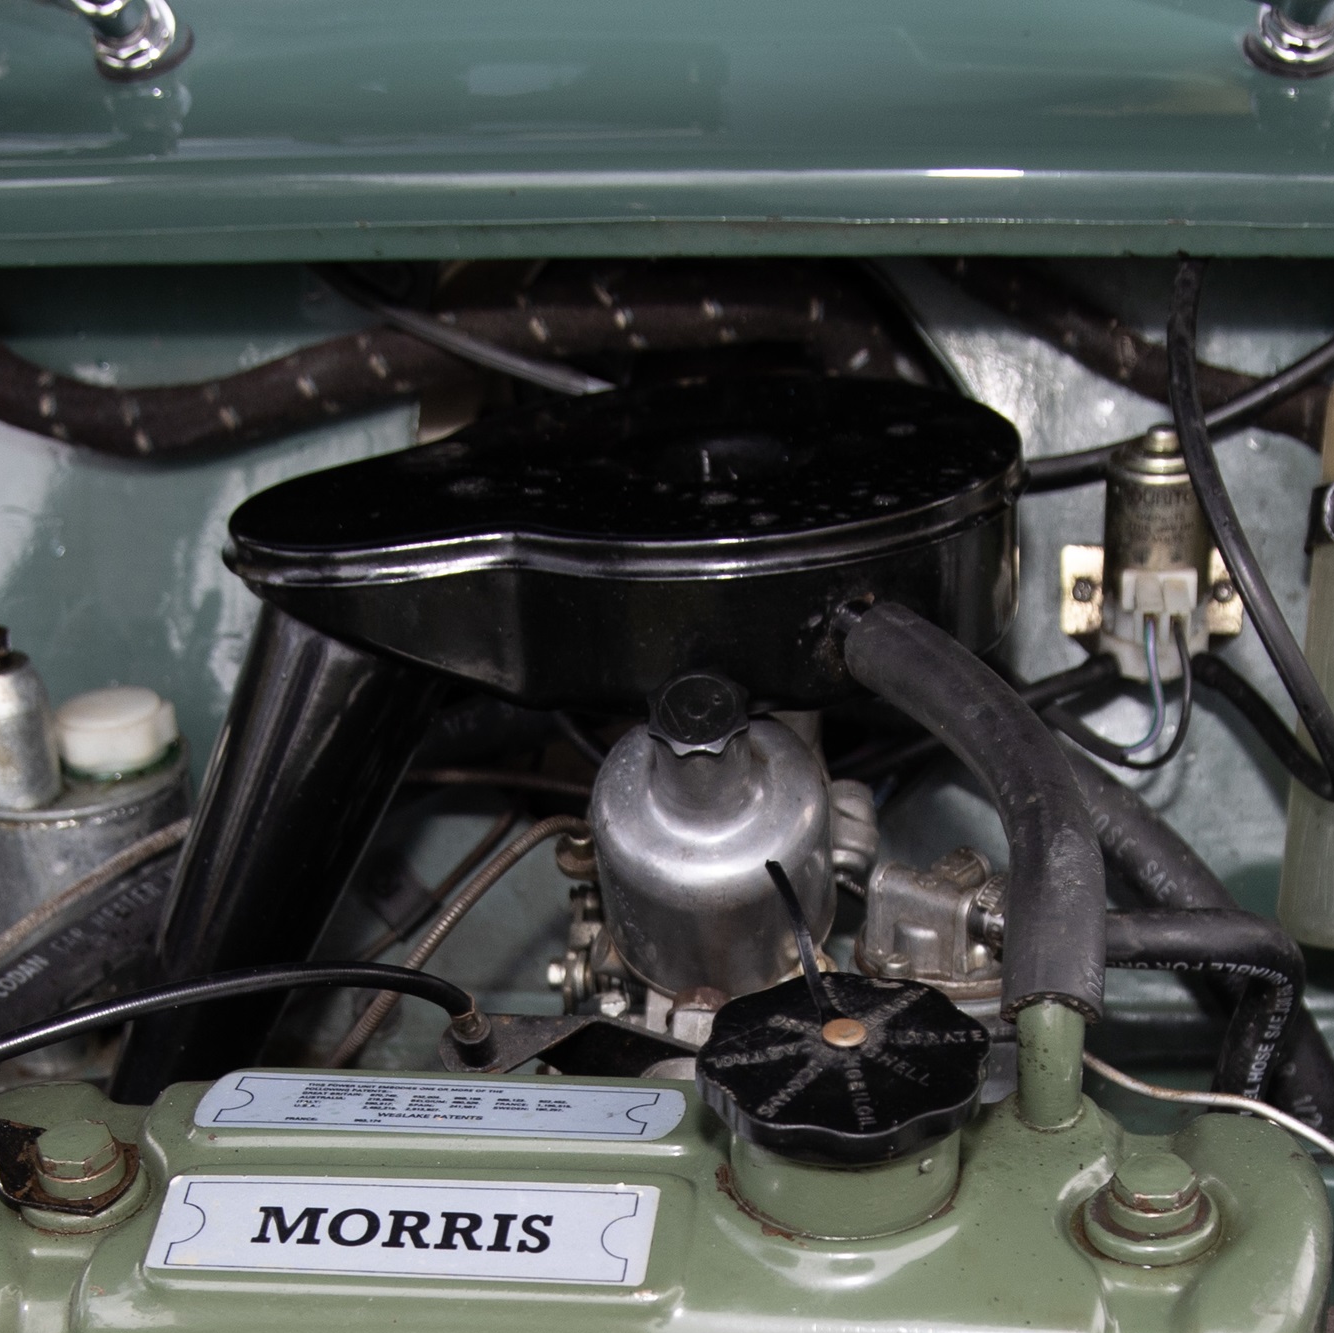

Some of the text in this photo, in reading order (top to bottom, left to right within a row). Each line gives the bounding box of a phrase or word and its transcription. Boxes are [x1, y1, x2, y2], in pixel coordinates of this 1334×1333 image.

[1246, 1042, 1276, 1083] HOSE
[1264, 1014, 1288, 1041] SAE
[250, 1205, 554, 1255] MORRIS
